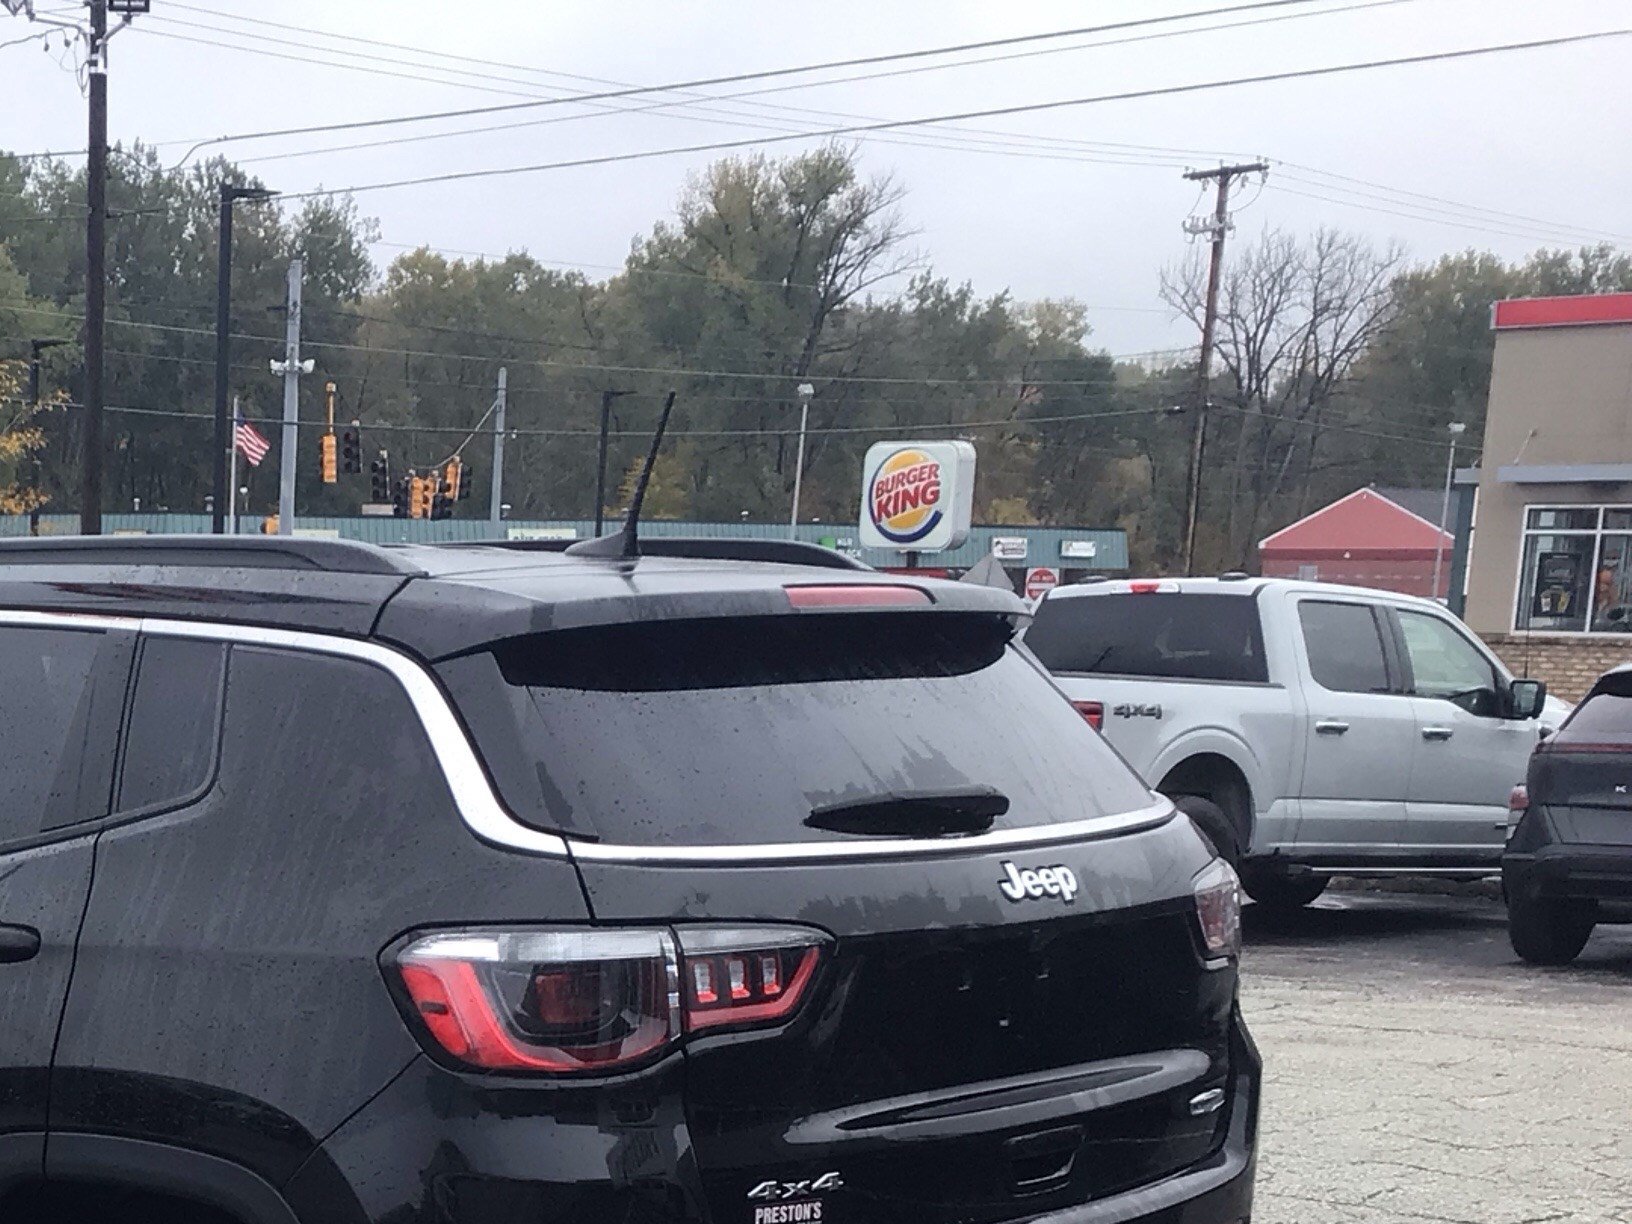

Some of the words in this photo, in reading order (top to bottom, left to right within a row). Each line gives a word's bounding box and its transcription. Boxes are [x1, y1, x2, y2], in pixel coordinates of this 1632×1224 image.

[875, 463, 940, 500] BURGER
[876, 480, 941, 523] KING
[997, 860, 1078, 903] Jeep
[754, 1202, 822, 1224] PRESTON'S
